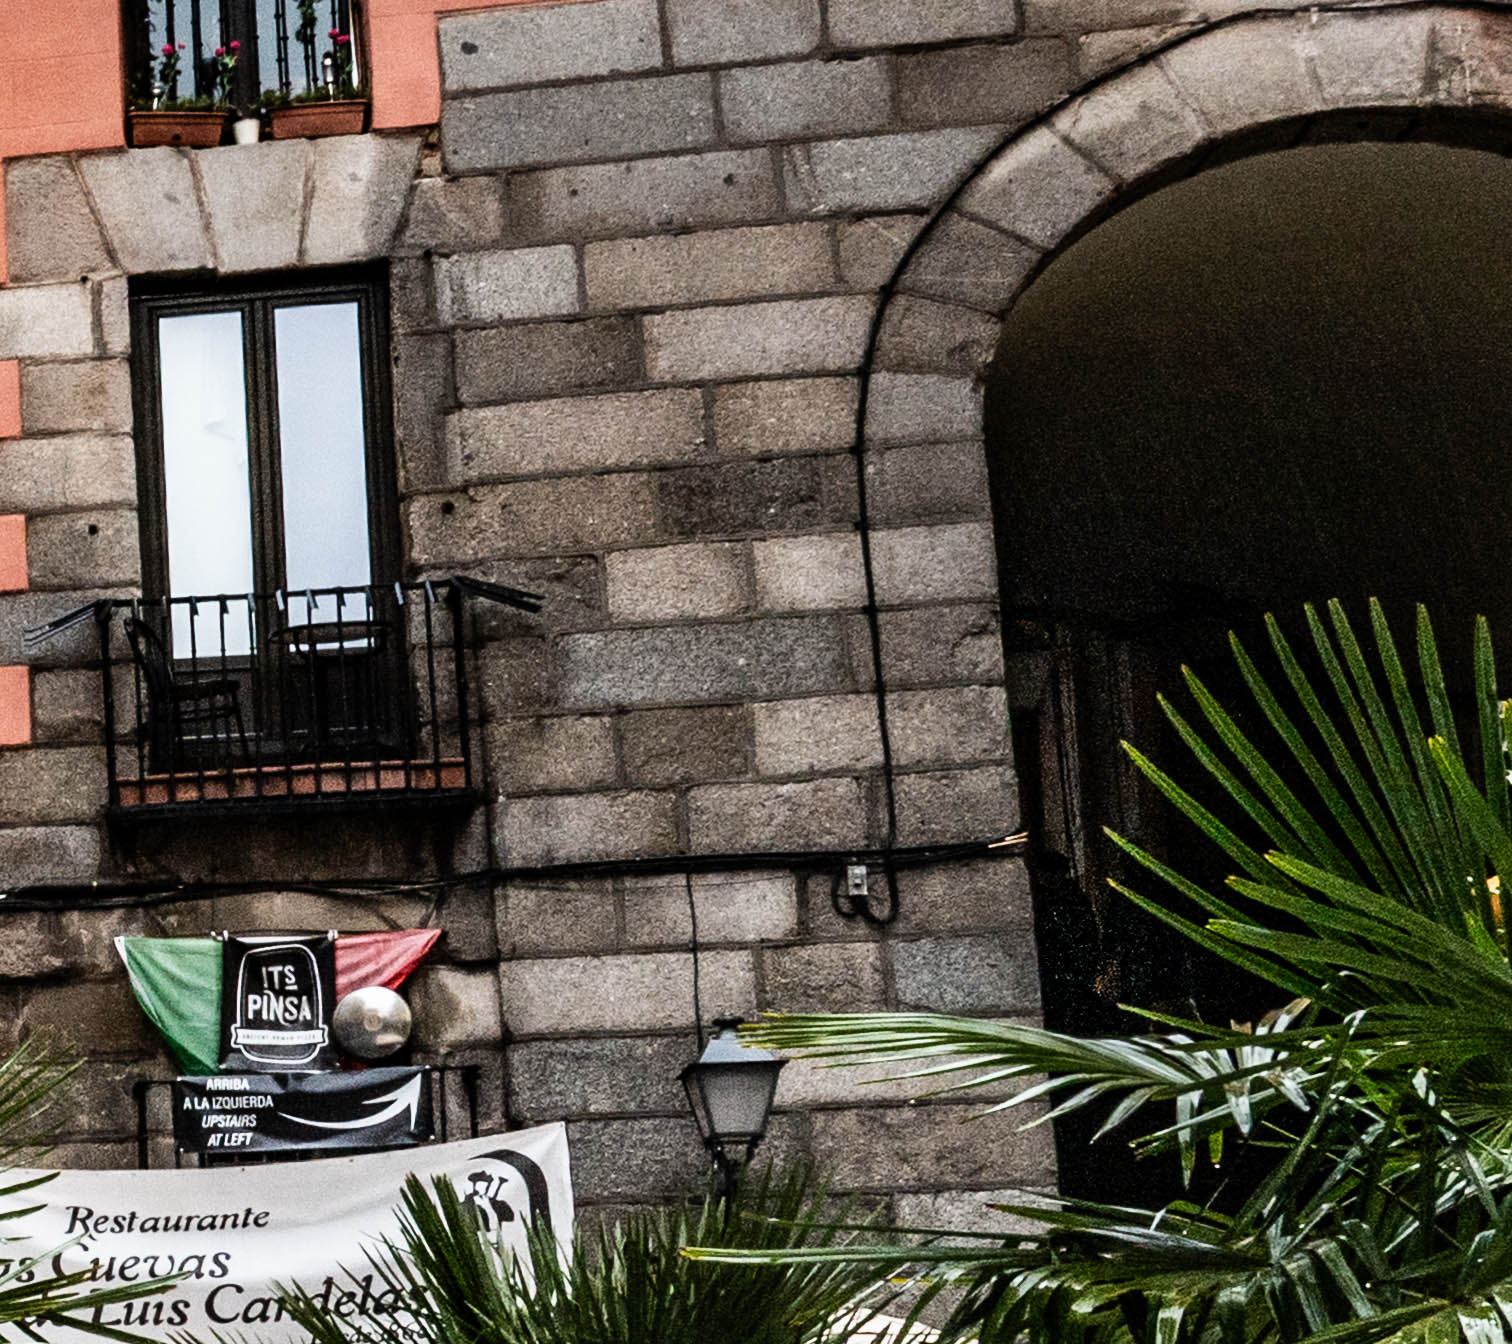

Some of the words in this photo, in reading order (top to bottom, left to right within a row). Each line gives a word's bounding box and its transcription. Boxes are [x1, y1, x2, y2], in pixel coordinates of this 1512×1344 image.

[247, 990, 312, 1027] PINSA
[206, 1078, 250, 1091] ARRIBA
[183, 1097, 192, 1111] A
[194, 1097, 210, 1110] LA
[212, 1095, 274, 1111] IZQUIERDA
[201, 1113, 257, 1128] UPSTAIRS
[207, 1133, 222, 1147] AT
[224, 1132, 254, 1147] LEFT
[64, 1205, 271, 1240] Restaurante
[51, 1241, 231, 1283] Cuevas
[89, 1287, 191, 1327] Luis
